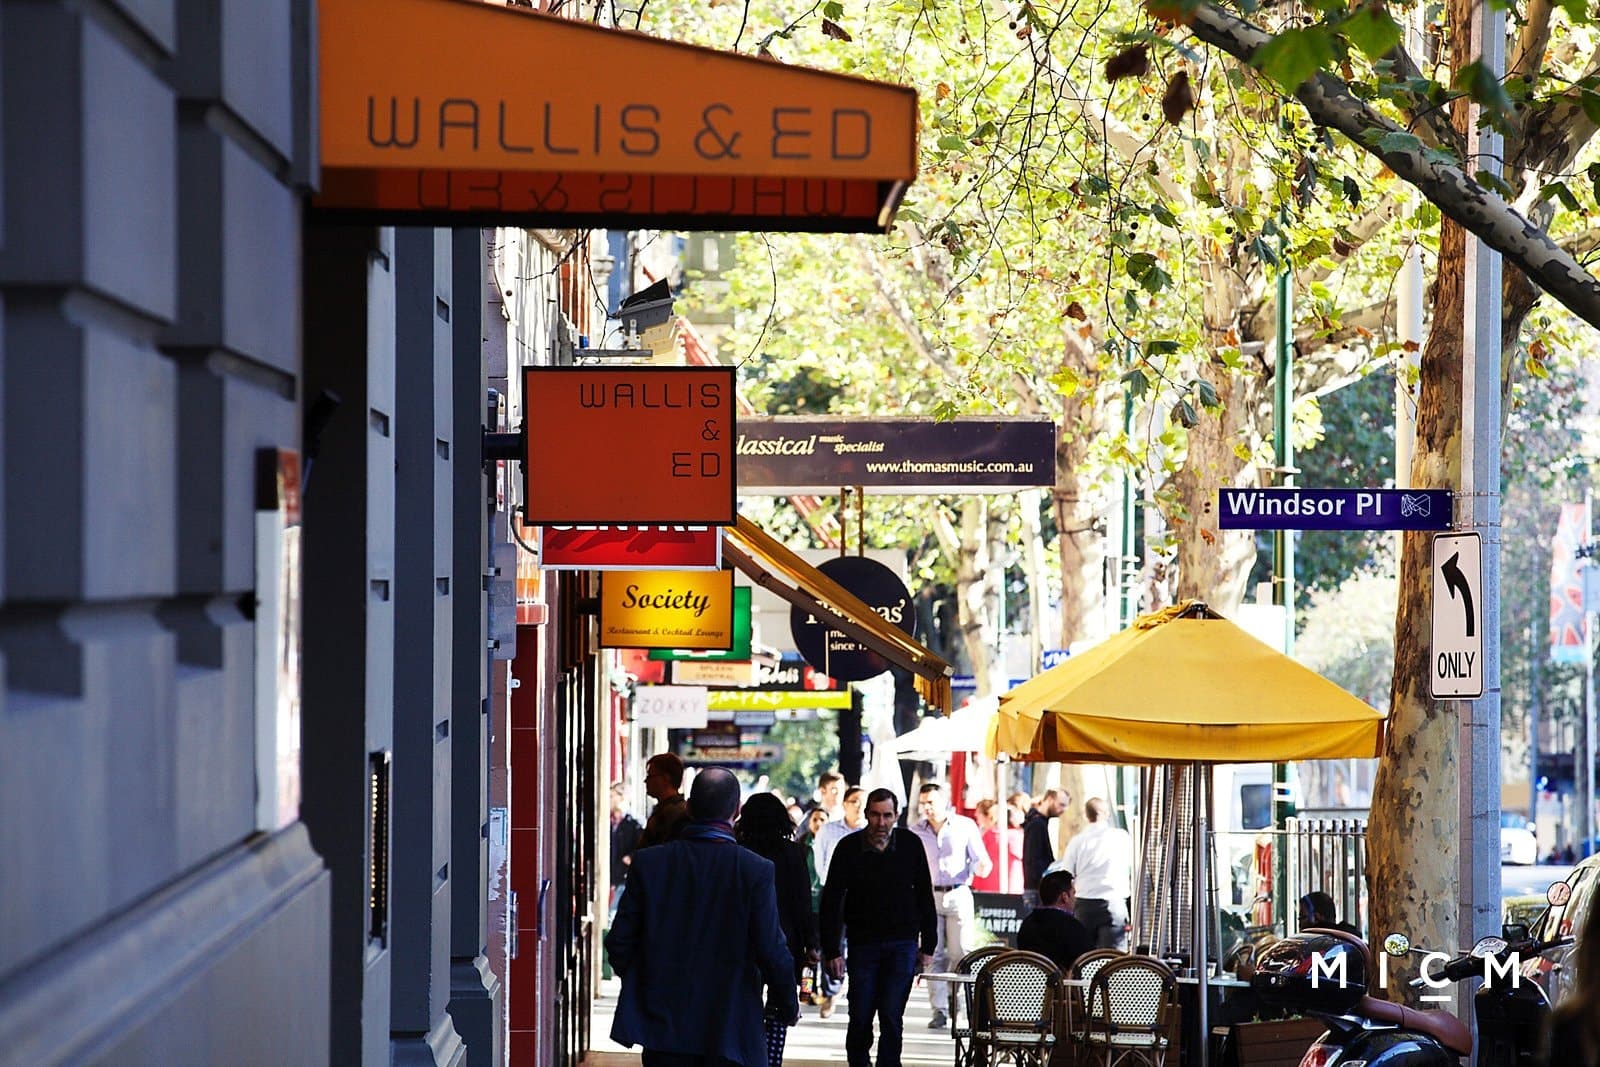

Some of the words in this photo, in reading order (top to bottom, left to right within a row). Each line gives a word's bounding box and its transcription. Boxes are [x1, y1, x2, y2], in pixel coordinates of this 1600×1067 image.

[366, 95, 661, 156] WALLIS
[693, 103, 742, 160] &
[771, 107, 873, 161] ED
[579, 383, 721, 409] WALLIS
[701, 419, 721, 441] &
[819, 434, 845, 443] music
[736, 434, 817, 455] lassical
[834, 441, 885, 455] specialist
[671, 452, 721, 478] ED
[866, 459, 1034, 474] www.thomasmusic.com.au
[1227, 492, 1346, 516] Windsor
[1356, 493, 1382, 516] Pl
[621, 584, 711, 618] Society
[606, 626, 651, 636] Restaurant
[662, 627, 693, 637] Cocktail
[829, 640, 856, 651] since
[1437, 652, 1476, 679] ONLY
[639, 697, 699, 714] ZOKKY
